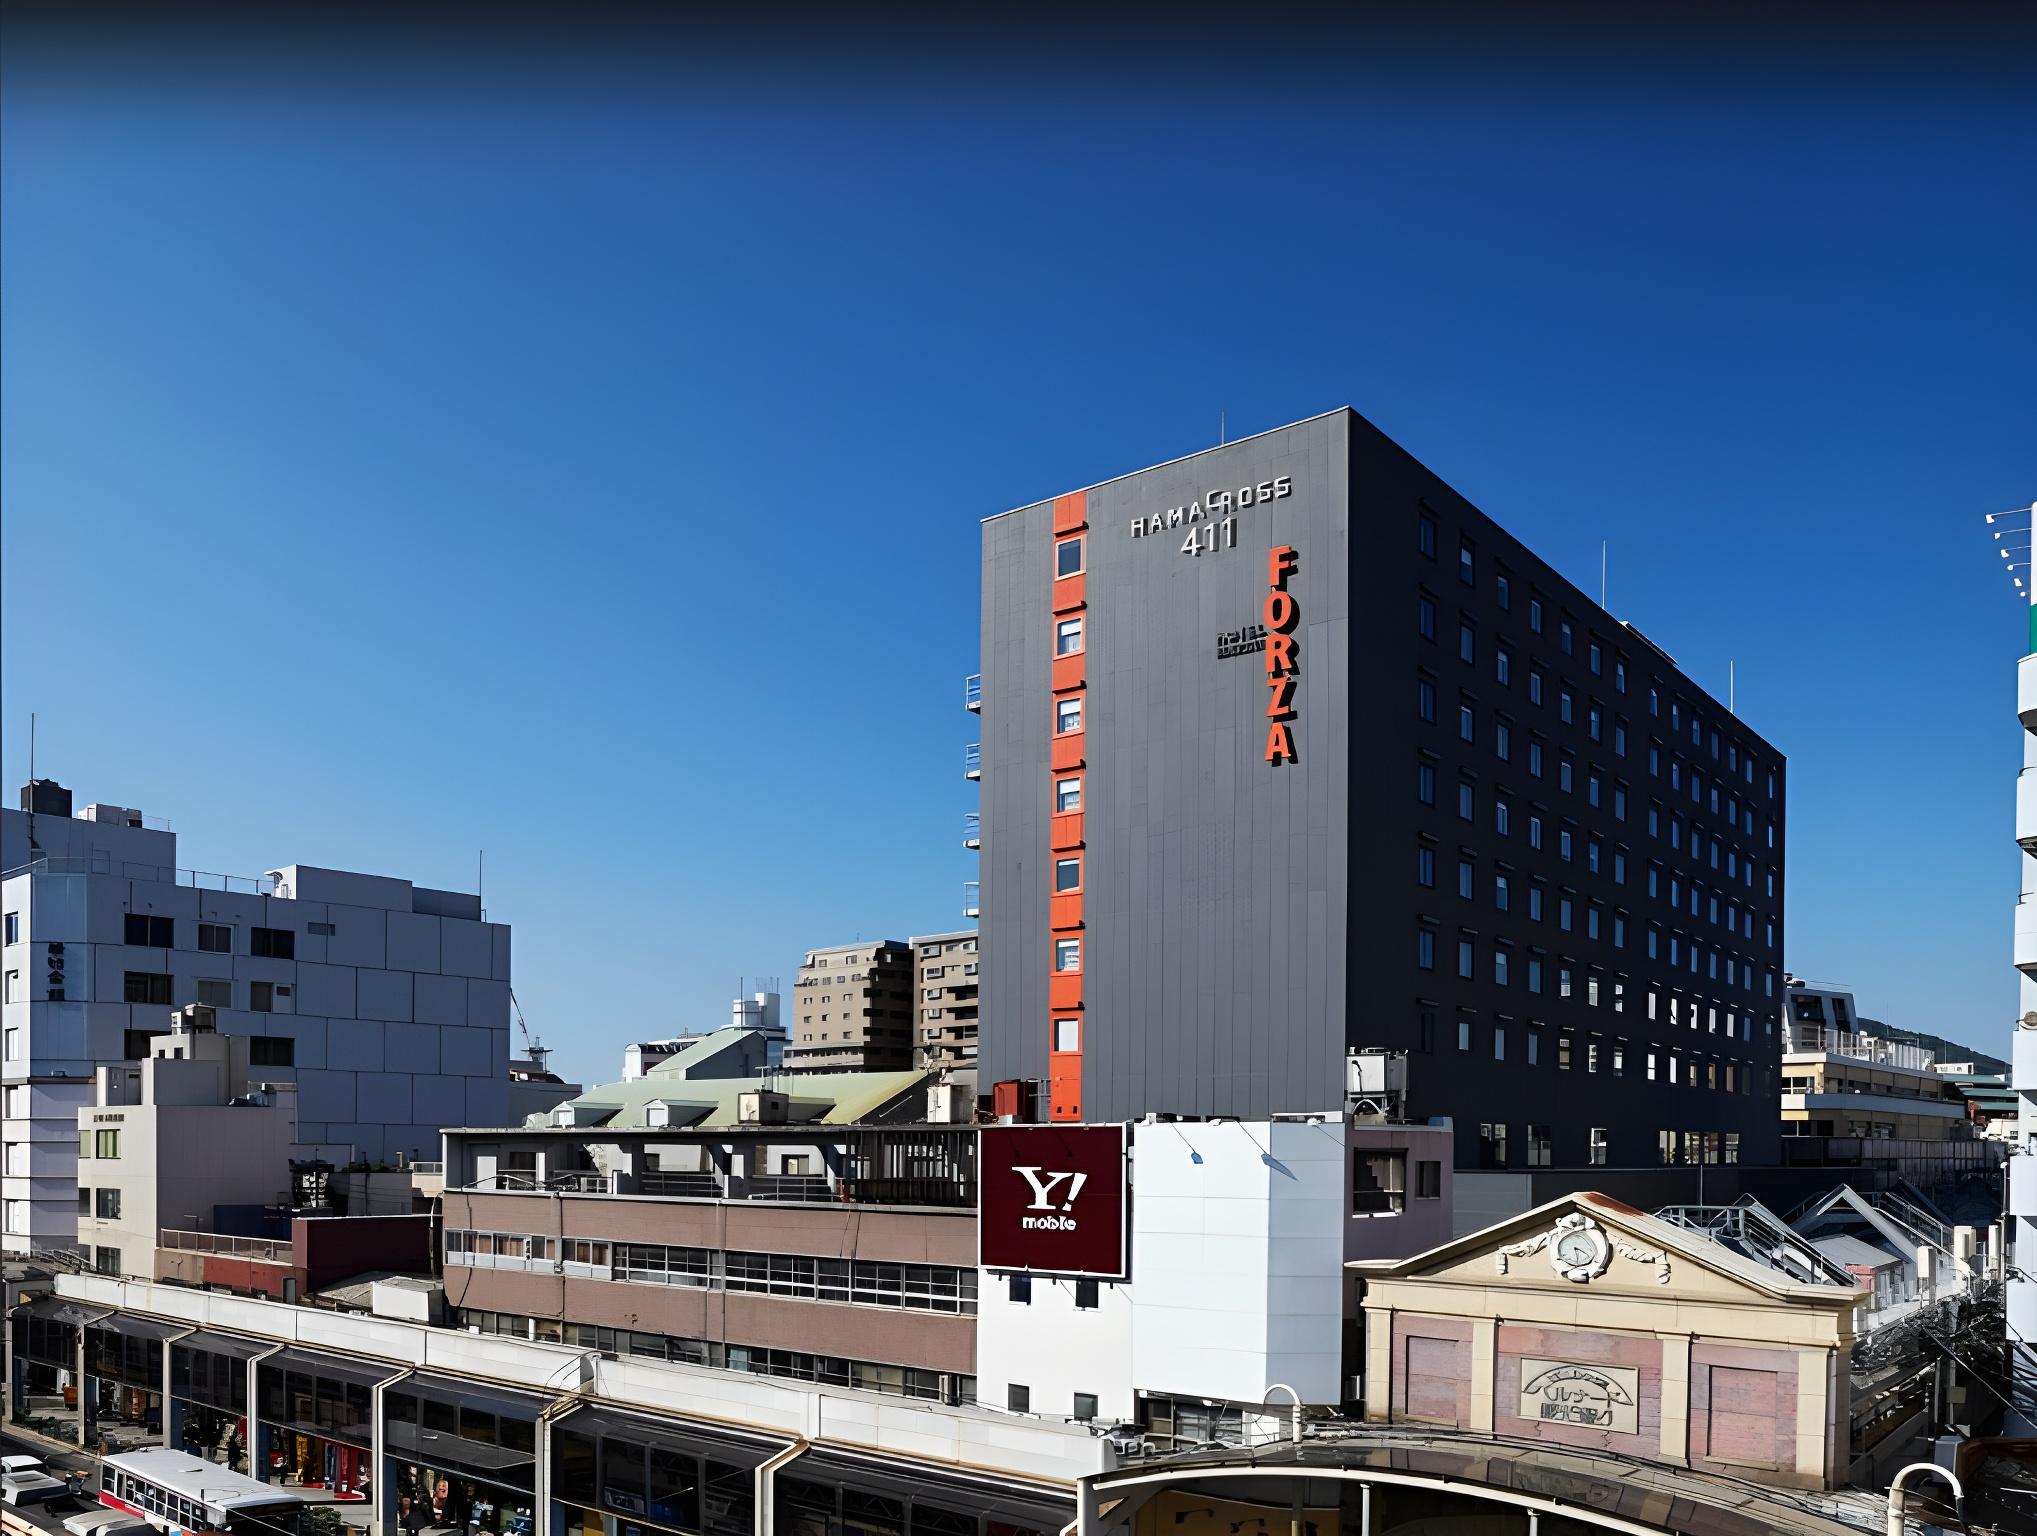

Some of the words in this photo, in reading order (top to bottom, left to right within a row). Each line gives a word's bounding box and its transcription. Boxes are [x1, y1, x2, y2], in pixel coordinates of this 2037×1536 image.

[1130, 476, 1292, 538] HAMACROSS
[1181, 517, 1238, 556] 411
[1263, 545, 1295, 764] FORZA
